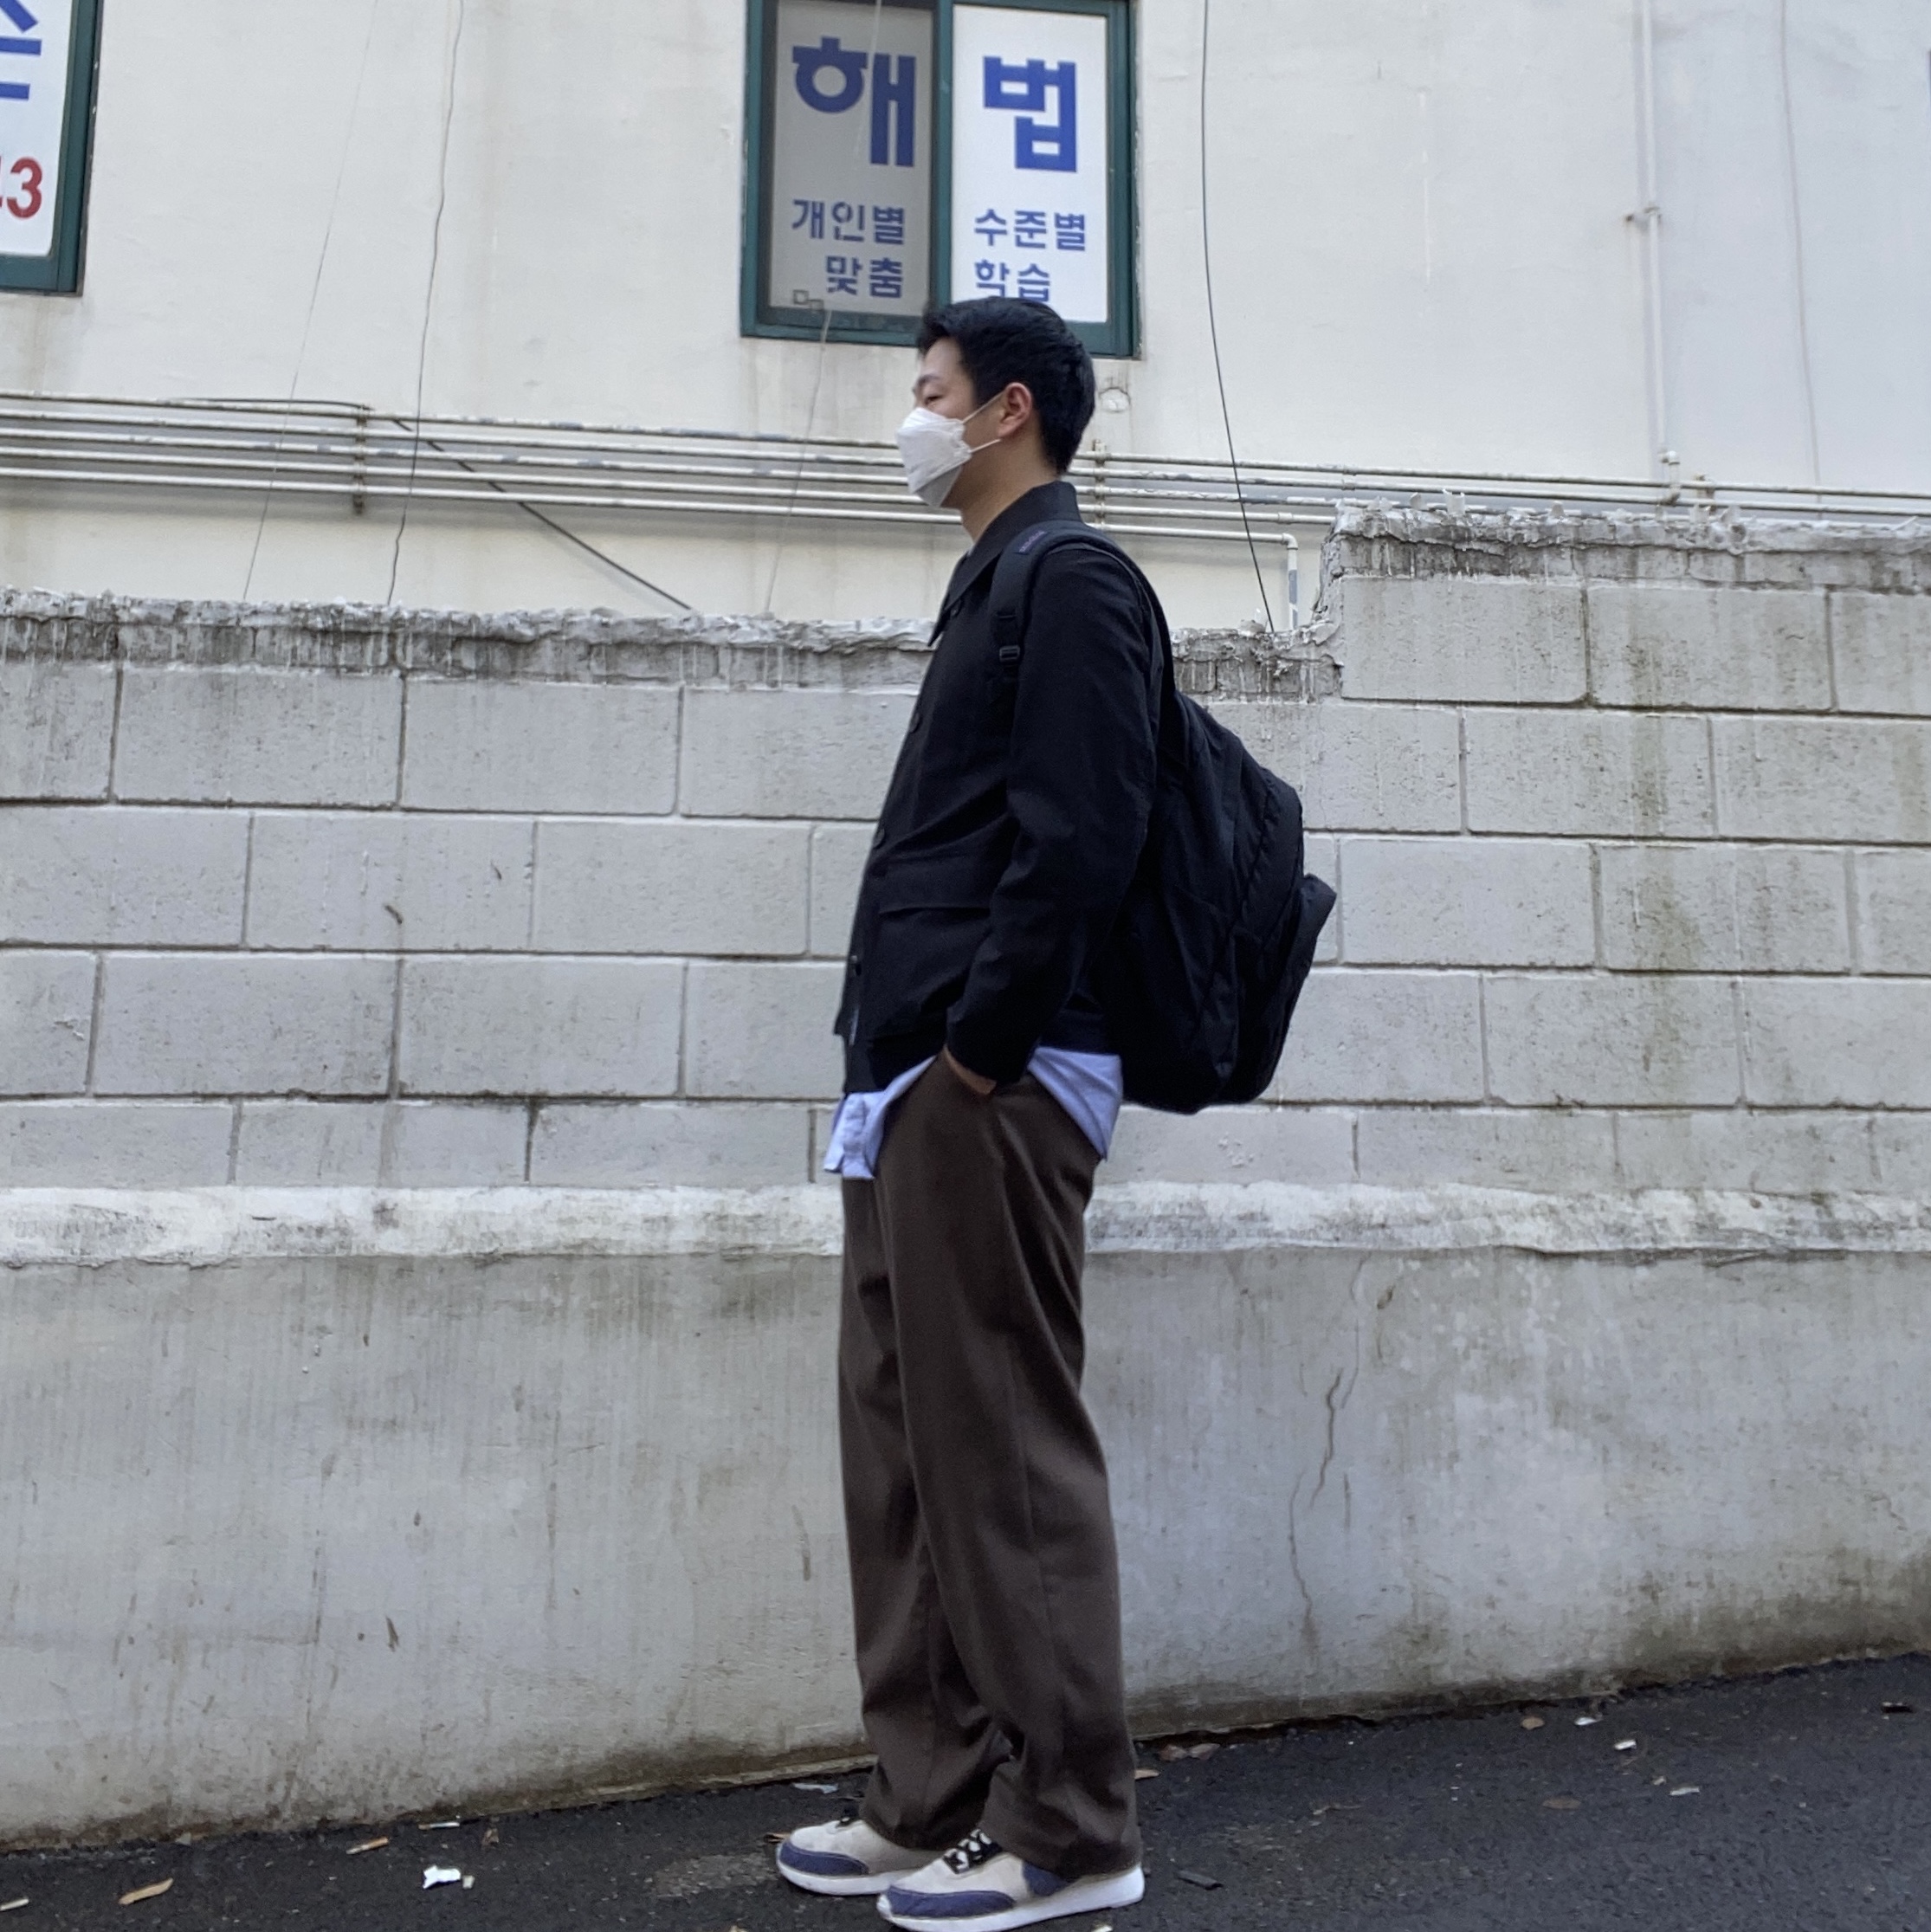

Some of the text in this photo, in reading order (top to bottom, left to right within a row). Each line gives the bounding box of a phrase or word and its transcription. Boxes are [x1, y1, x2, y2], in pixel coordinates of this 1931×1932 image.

[0, 157, 42, 219] 3
[791, 199, 904, 244] 개인별
[974, 209, 1085, 251] 수준별
[826, 256, 902, 298] 맞춤
[974, 259, 1049, 302] 학습
